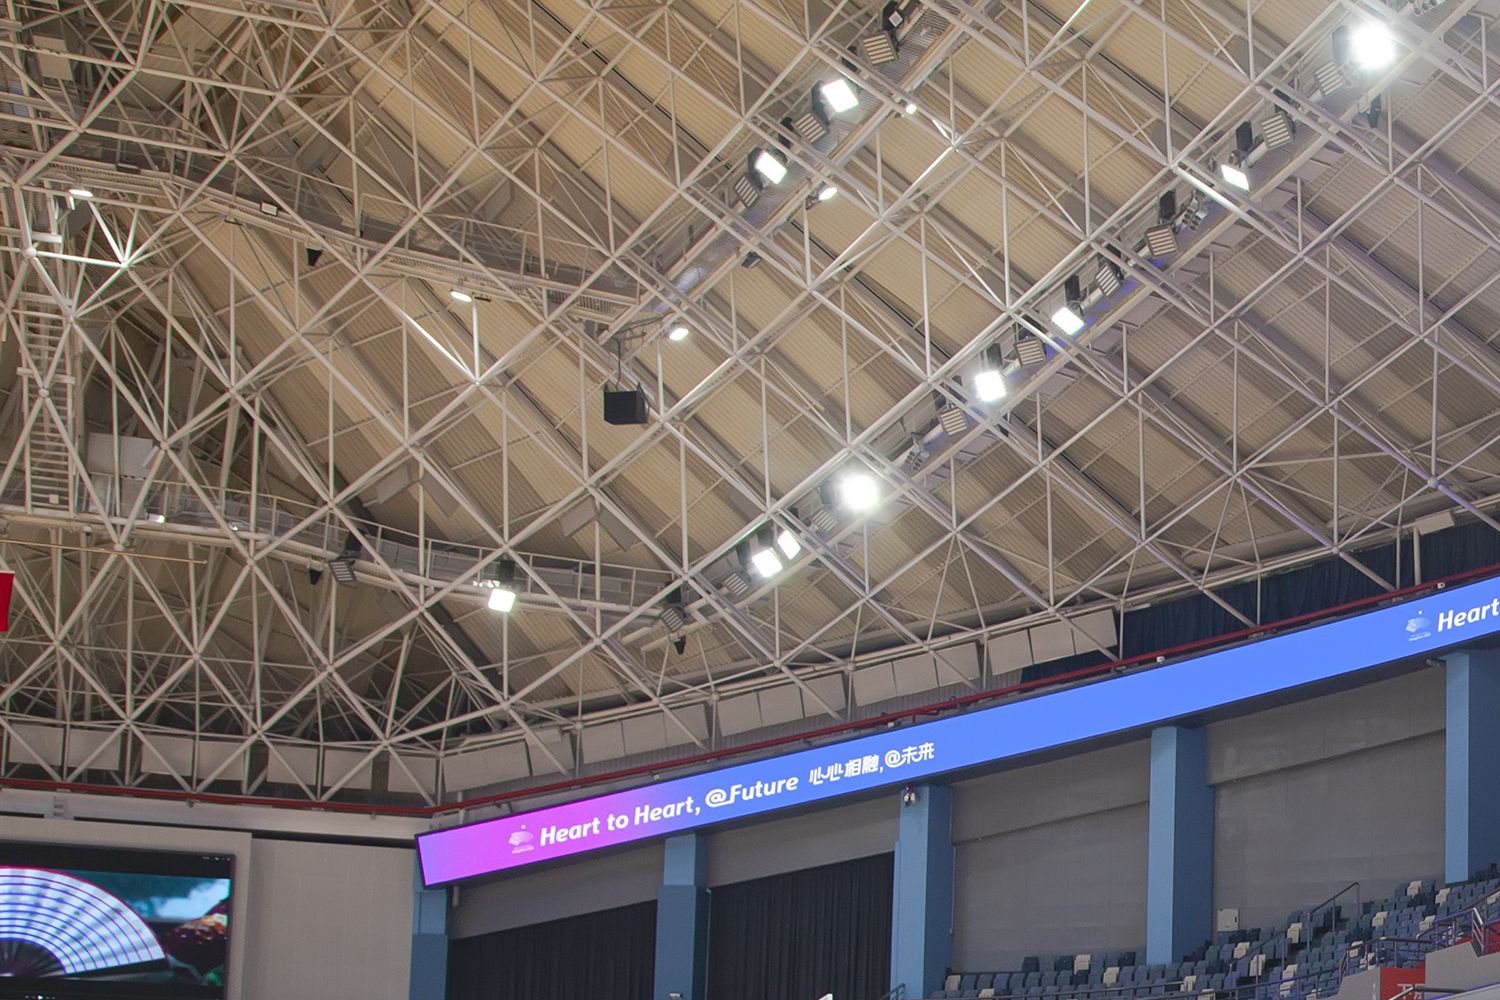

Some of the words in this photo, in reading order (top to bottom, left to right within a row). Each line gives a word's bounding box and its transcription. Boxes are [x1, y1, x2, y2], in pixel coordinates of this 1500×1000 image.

[1437, 598, 1499, 632] Heart
[540, 817, 601, 847] Heart
[607, 814, 629, 832] to
[634, 796, 701, 827] Heart,
[705, 776, 799, 808] @Future
